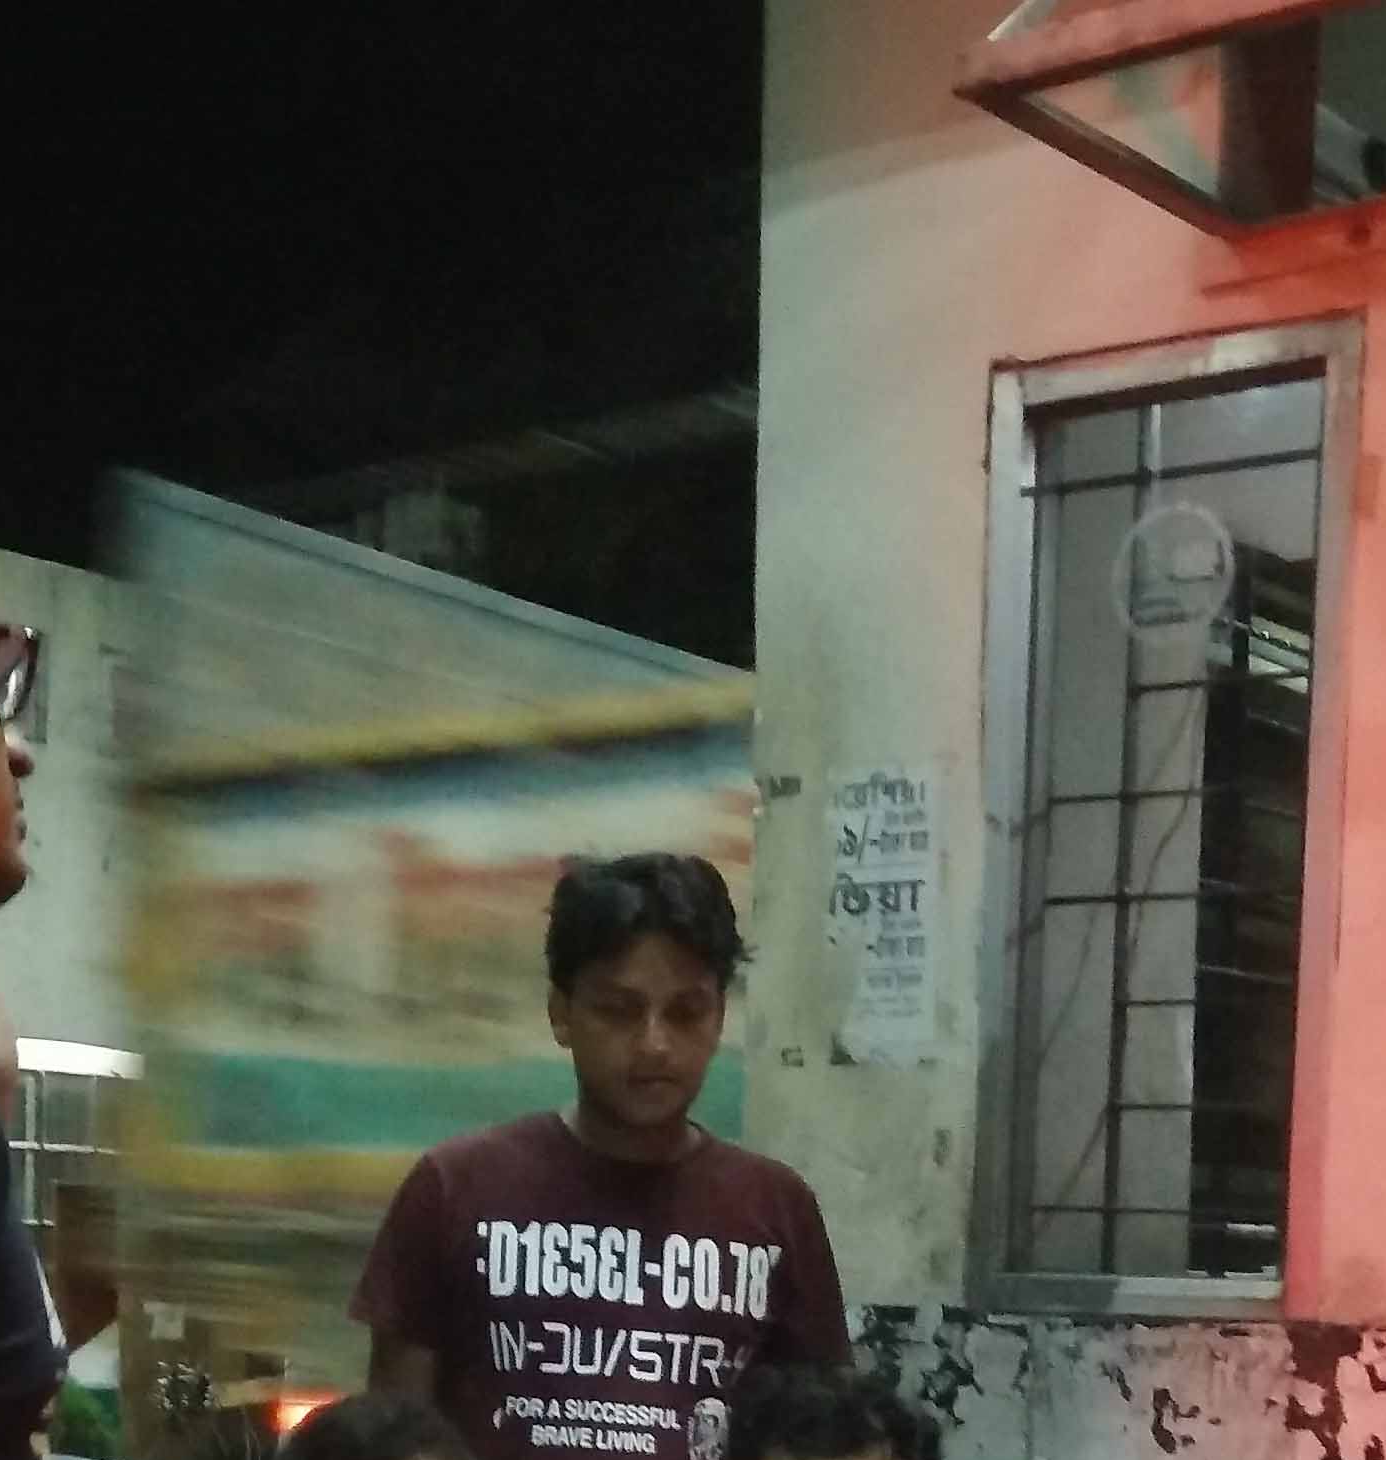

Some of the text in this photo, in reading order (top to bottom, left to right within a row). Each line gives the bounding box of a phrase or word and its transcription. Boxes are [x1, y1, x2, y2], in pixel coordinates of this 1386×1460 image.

[504, 1395, 680, 1430] FOR A SUCCESSFUL
[531, 1424, 657, 1454] BRAVE LIVING
